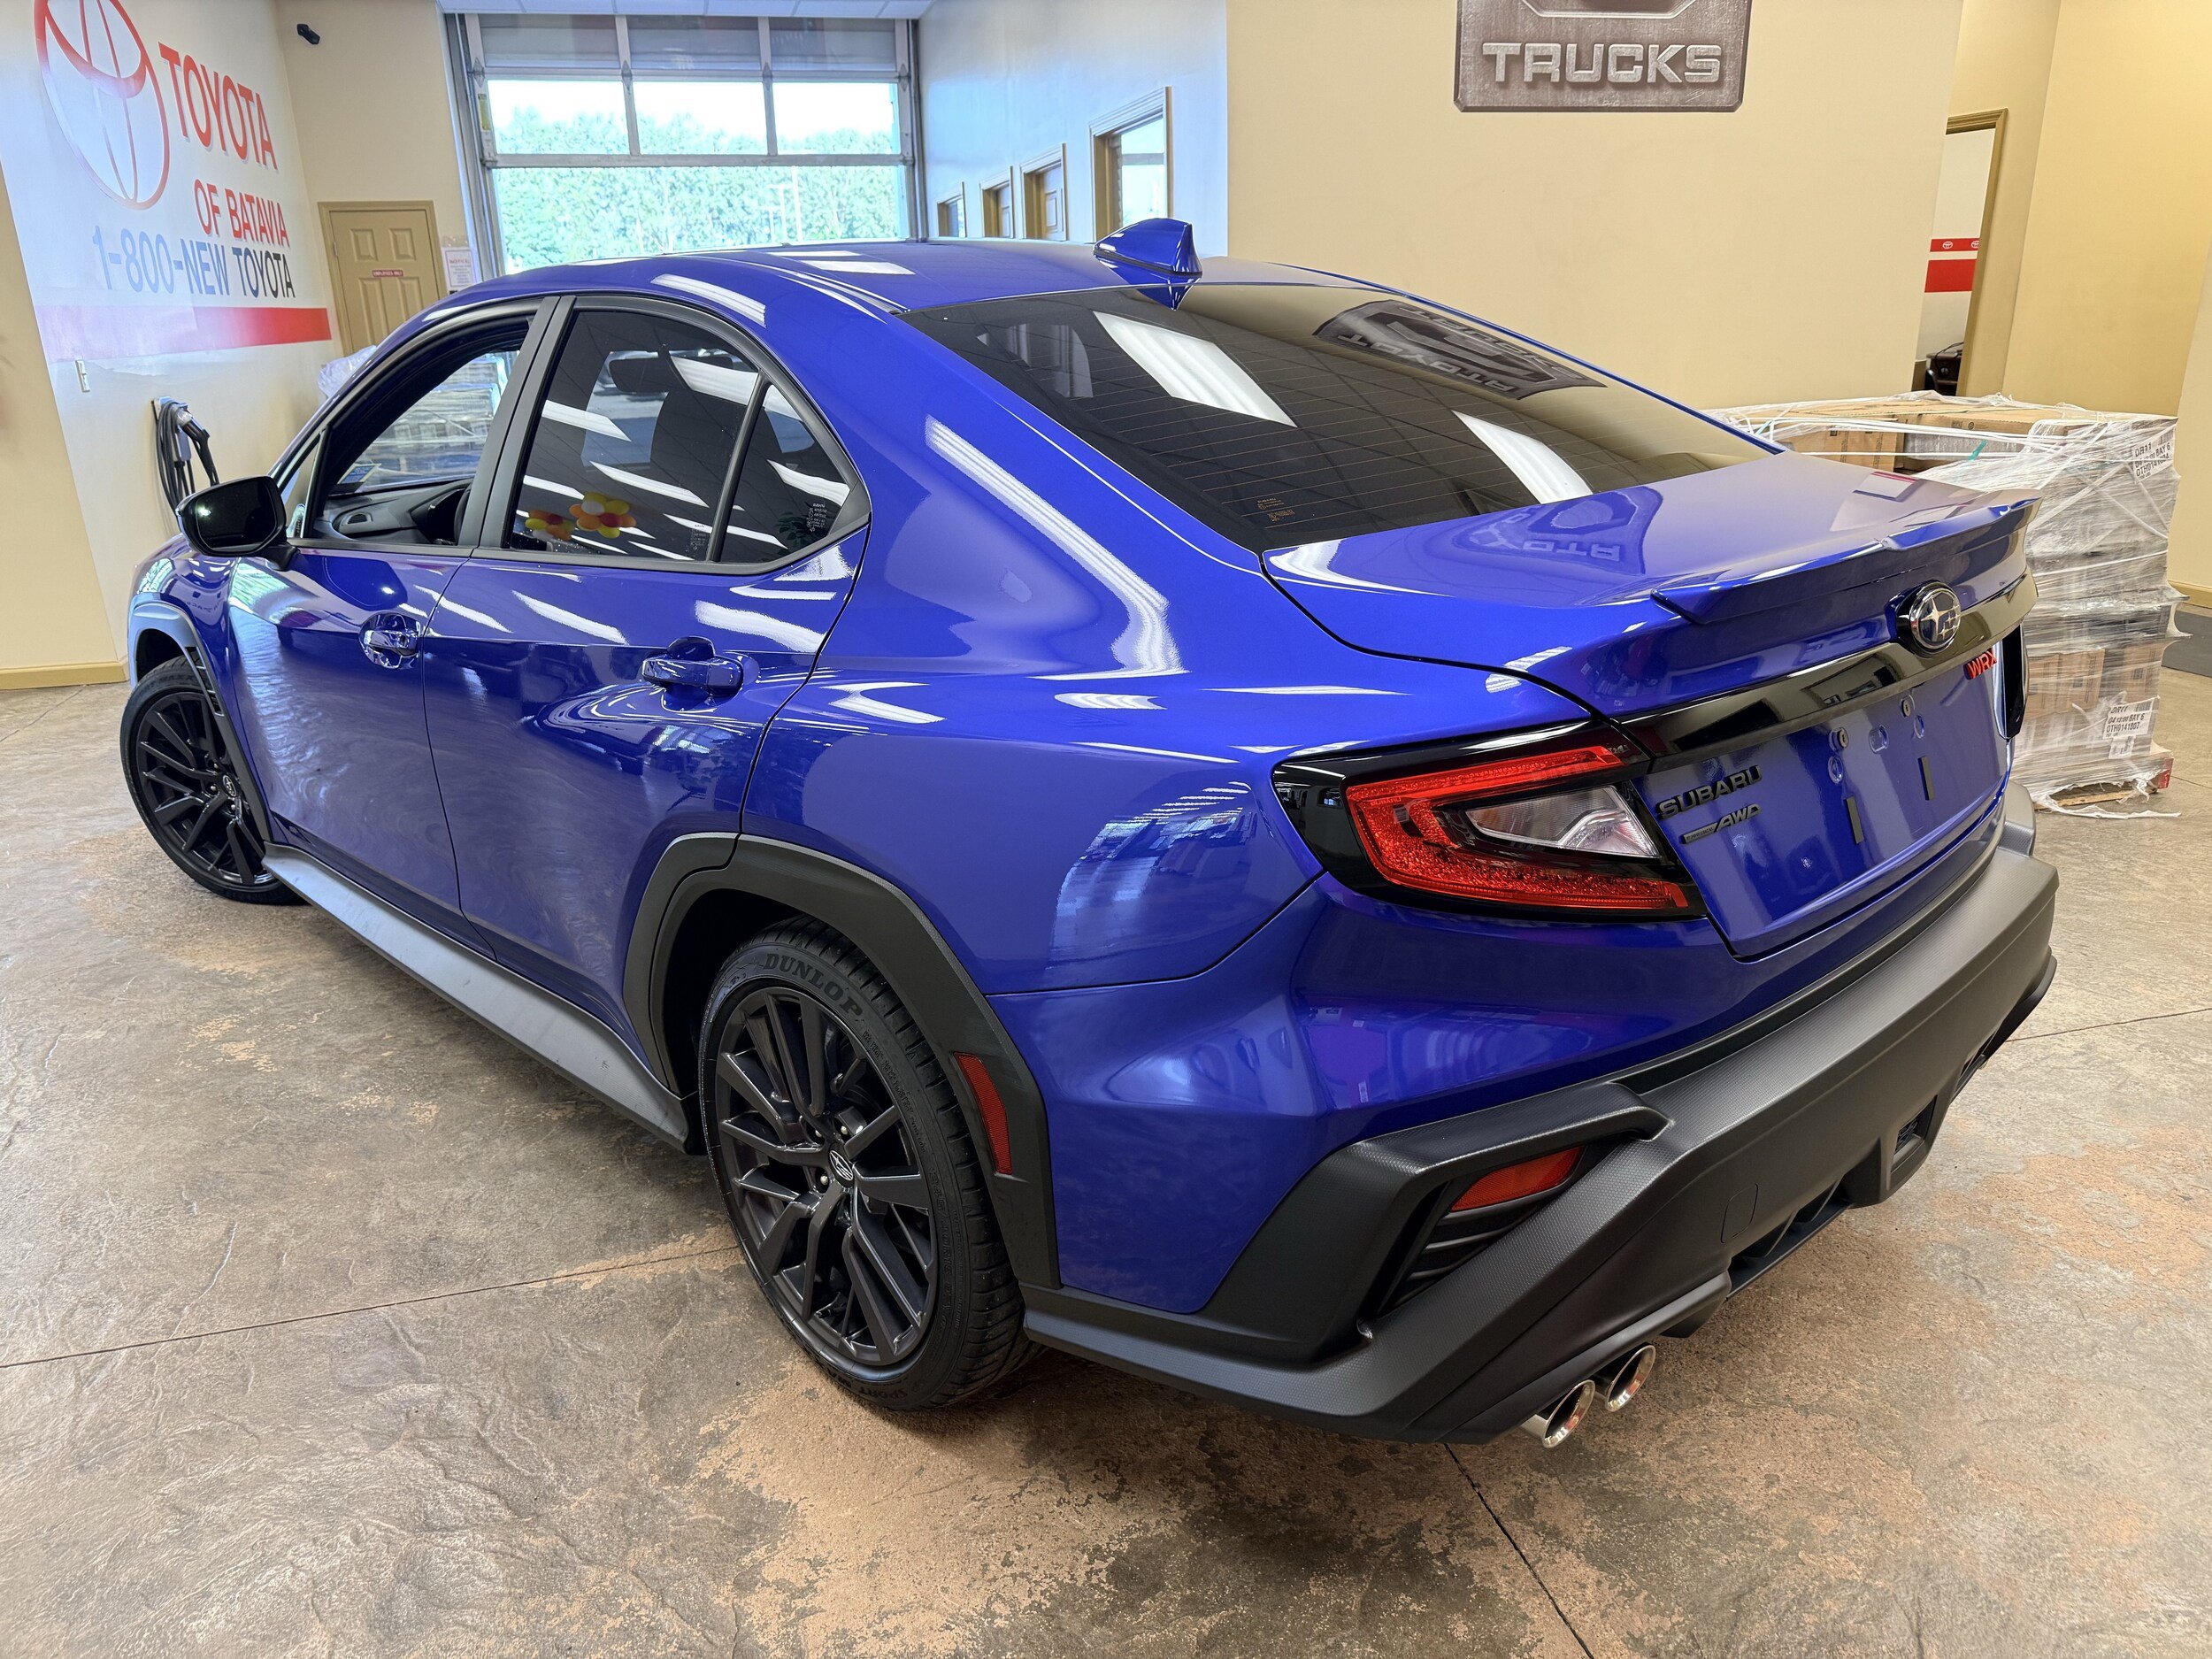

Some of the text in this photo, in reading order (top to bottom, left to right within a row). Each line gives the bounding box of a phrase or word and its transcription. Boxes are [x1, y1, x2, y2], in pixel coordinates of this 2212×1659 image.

[1482, 42, 1722, 83] TRUCKS
[158, 42, 278, 170] TOYOTA
[194, 179, 290, 248] OF BATAVIA
[92, 226, 296, 298] 1-800-NEW TOYOTA
[1965, 648, 1997, 680] WRX
[1657, 765, 1762, 820] SUBARU
[1717, 803, 1762, 833] AWD
[763, 953, 864, 1017] DUNLOP
